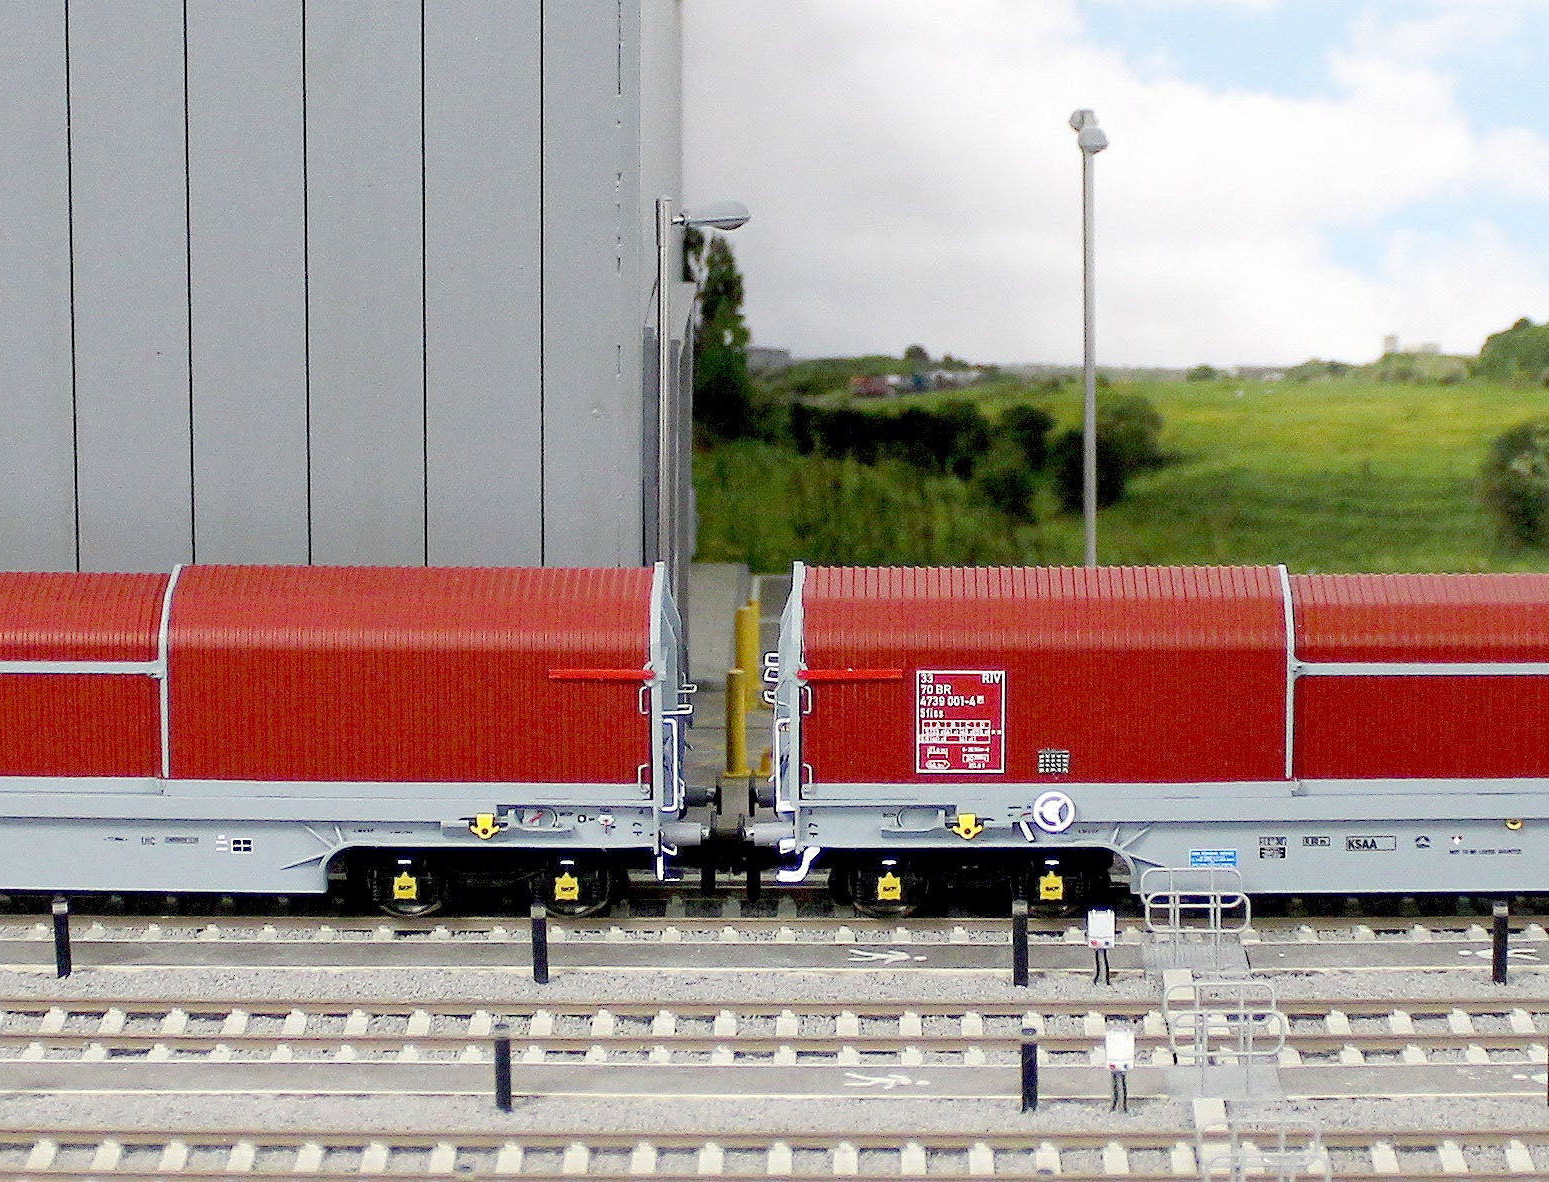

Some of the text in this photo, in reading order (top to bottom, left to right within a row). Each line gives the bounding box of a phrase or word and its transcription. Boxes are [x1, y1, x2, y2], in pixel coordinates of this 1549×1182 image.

[920, 673, 933, 683] 33
[981, 673, 1001, 684] RIV
[920, 684, 952, 695] 70 BR
[919, 695, 945, 706] 4739
[947, 695, 976, 707] 001-4
[1347, 839, 1378, 850] KSAA
